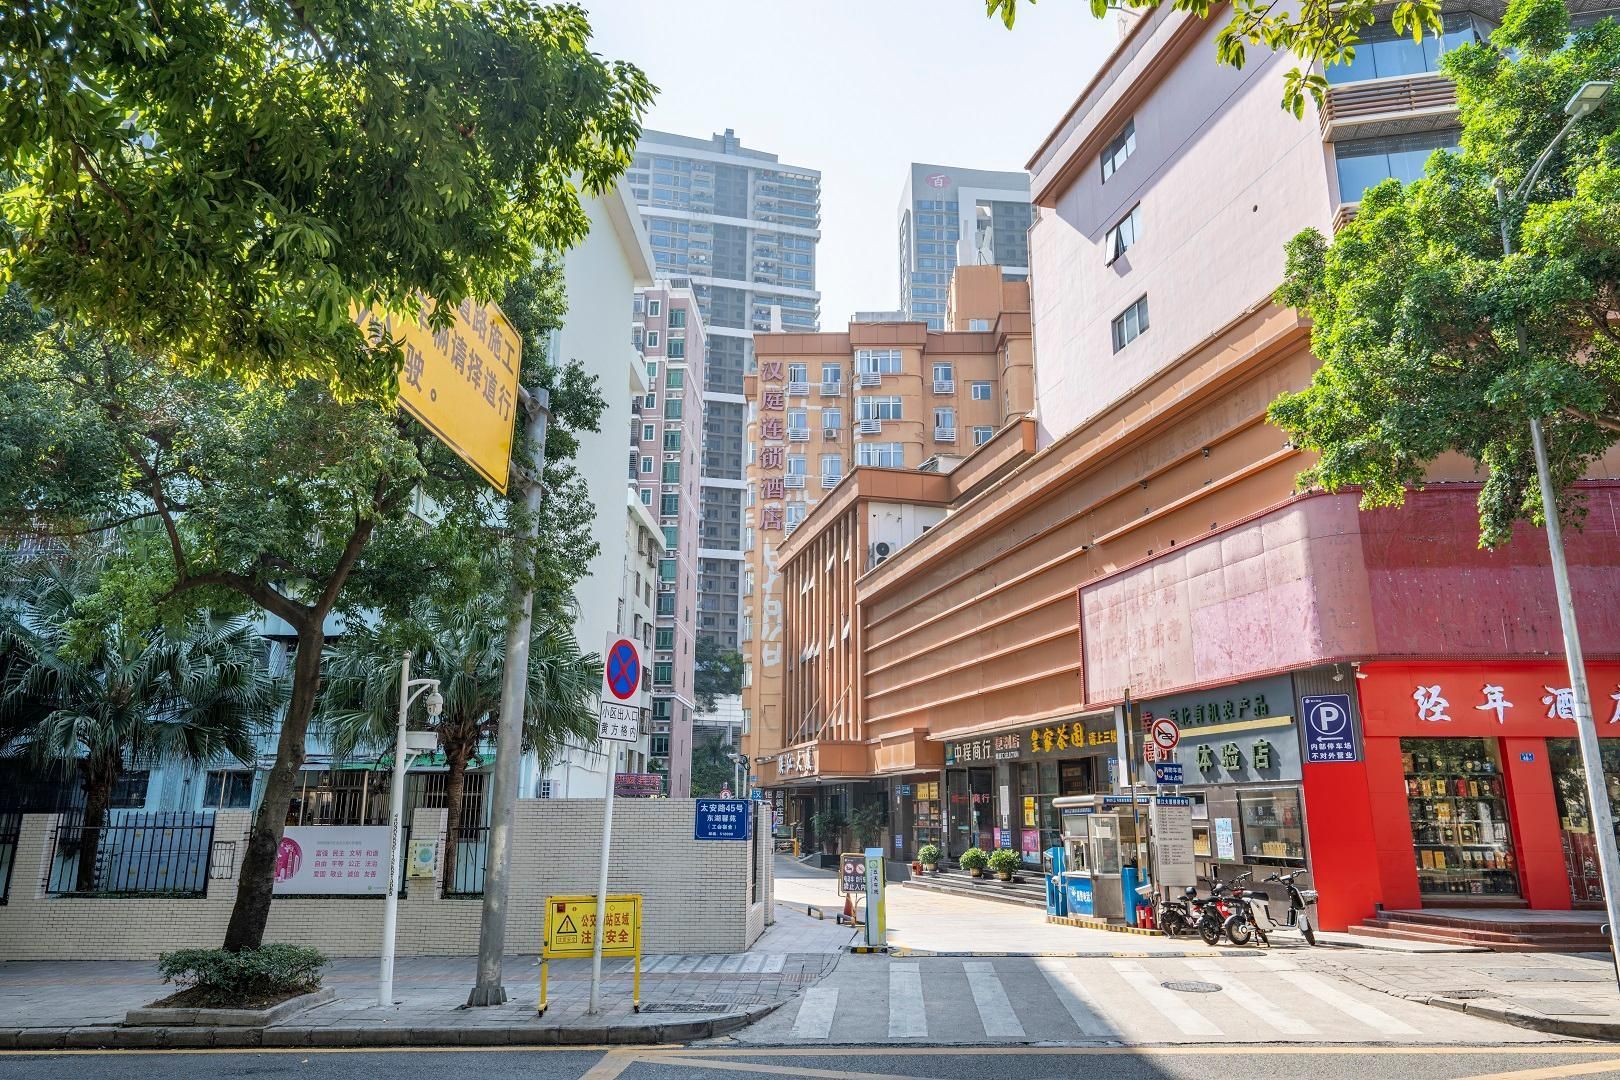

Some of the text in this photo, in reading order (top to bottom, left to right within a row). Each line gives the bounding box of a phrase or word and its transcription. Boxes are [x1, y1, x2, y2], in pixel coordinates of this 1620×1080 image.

[931, 175, 945, 187] 百
[760, 361, 785, 530] 汉庭连锁酒店
[602, 705, 638, 721] 小区出入口
[601, 722, 636, 738] 黄方格内
[954, 739, 991, 763] 中程商行
[1311, 742, 1352, 750] 内部停车场
[1197, 739, 1270, 772] 体验店
[1312, 752, 1353, 760] 不对外营业
[700, 803, 744, 812] 太安路45号
[706, 814, 737, 822] 东湖馨苑
[581, 912, 630, 928] 公交站区域
[581, 929, 629, 944] 注安全
